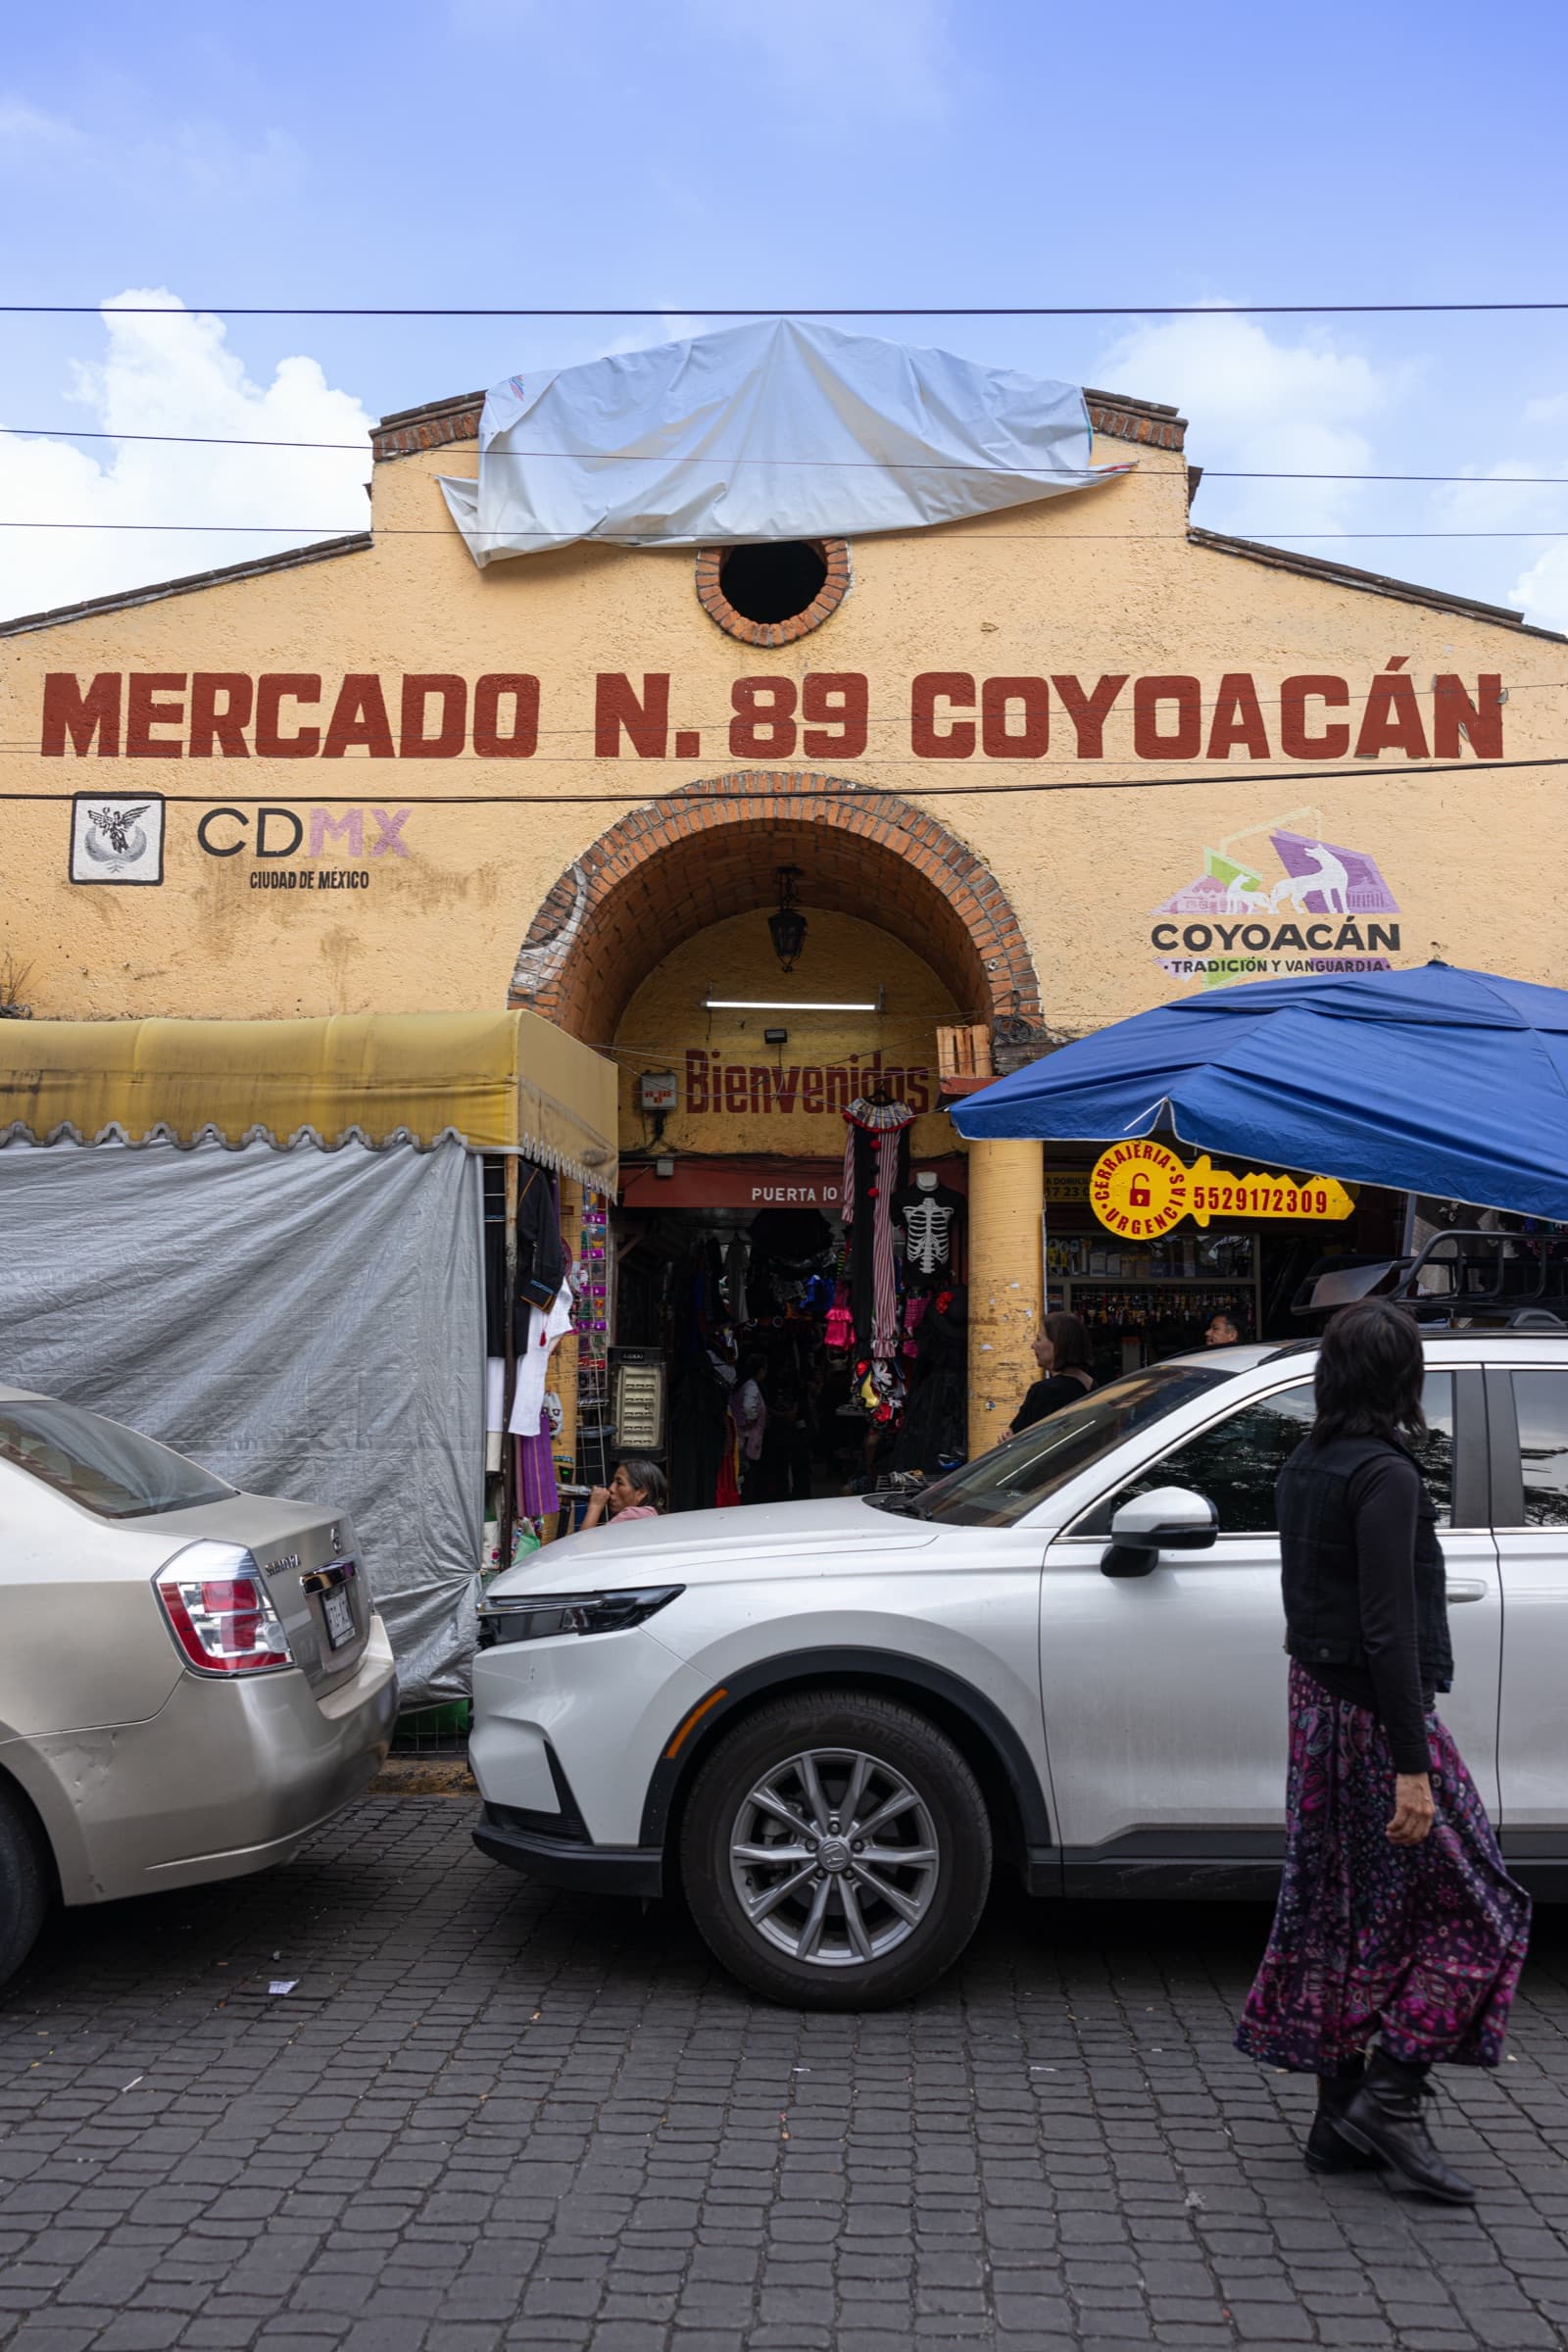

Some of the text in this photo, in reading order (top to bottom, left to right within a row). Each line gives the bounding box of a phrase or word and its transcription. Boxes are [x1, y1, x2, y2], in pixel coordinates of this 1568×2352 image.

[40, 656, 1503, 760] MERCADO N. 89 COYOACÁN
[197, 807, 412, 858] CDMX
[250, 866, 369, 890] CIUDAD DE MÉXICO
[1152, 915, 1400, 952] COYOACÁN
[1171, 956, 1383, 973] TRADICIÓN Y VANGUARDIA
[686, 1049, 929, 1113] Bienvenidos
[752, 1188, 815, 1200] PUERTA
[1095, 1144, 1171, 1200] CERRAJERIA
[1105, 1174, 1186, 1234] URGENCIAS
[1194, 1187, 1327, 1213] 5529172309
